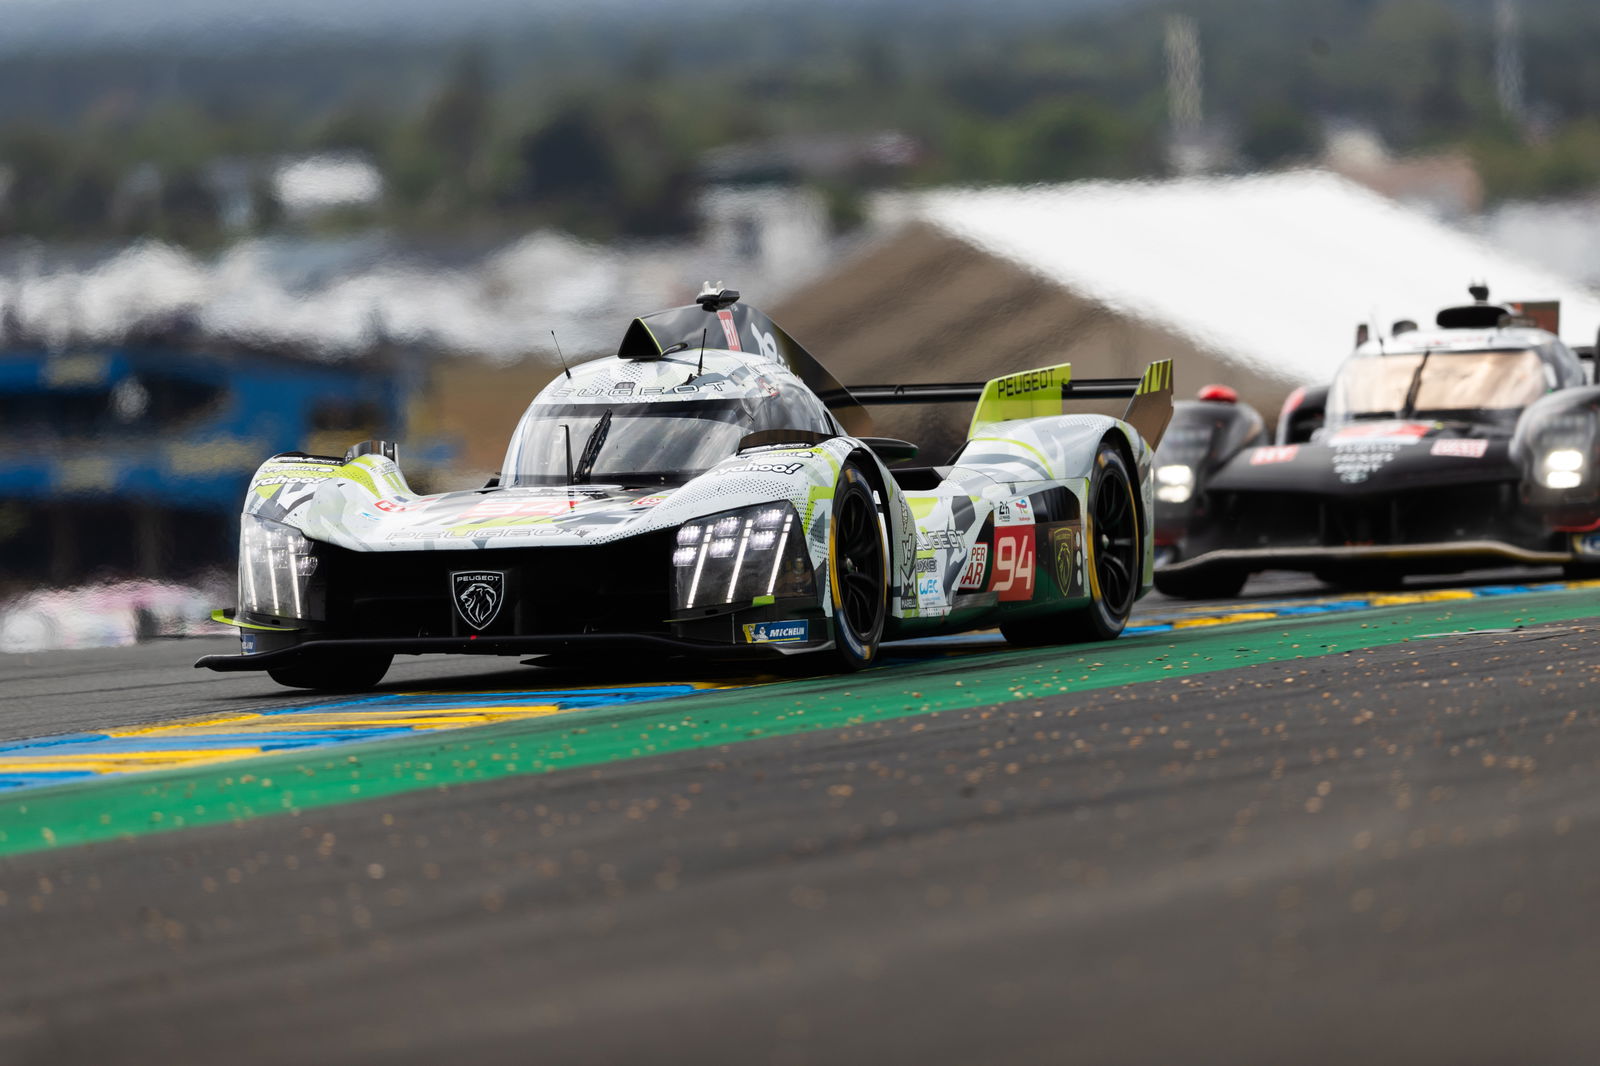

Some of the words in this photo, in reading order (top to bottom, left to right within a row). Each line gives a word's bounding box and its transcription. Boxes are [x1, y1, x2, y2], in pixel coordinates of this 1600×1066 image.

[551, 381, 725, 397] EUGEOT
[997, 368, 1055, 399] PEUGEOT
[712, 462, 804, 475] yahoo!
[992, 535, 1033, 591] 94
[961, 562, 984, 585] AR
[769, 627, 805, 637] MICHELIN
